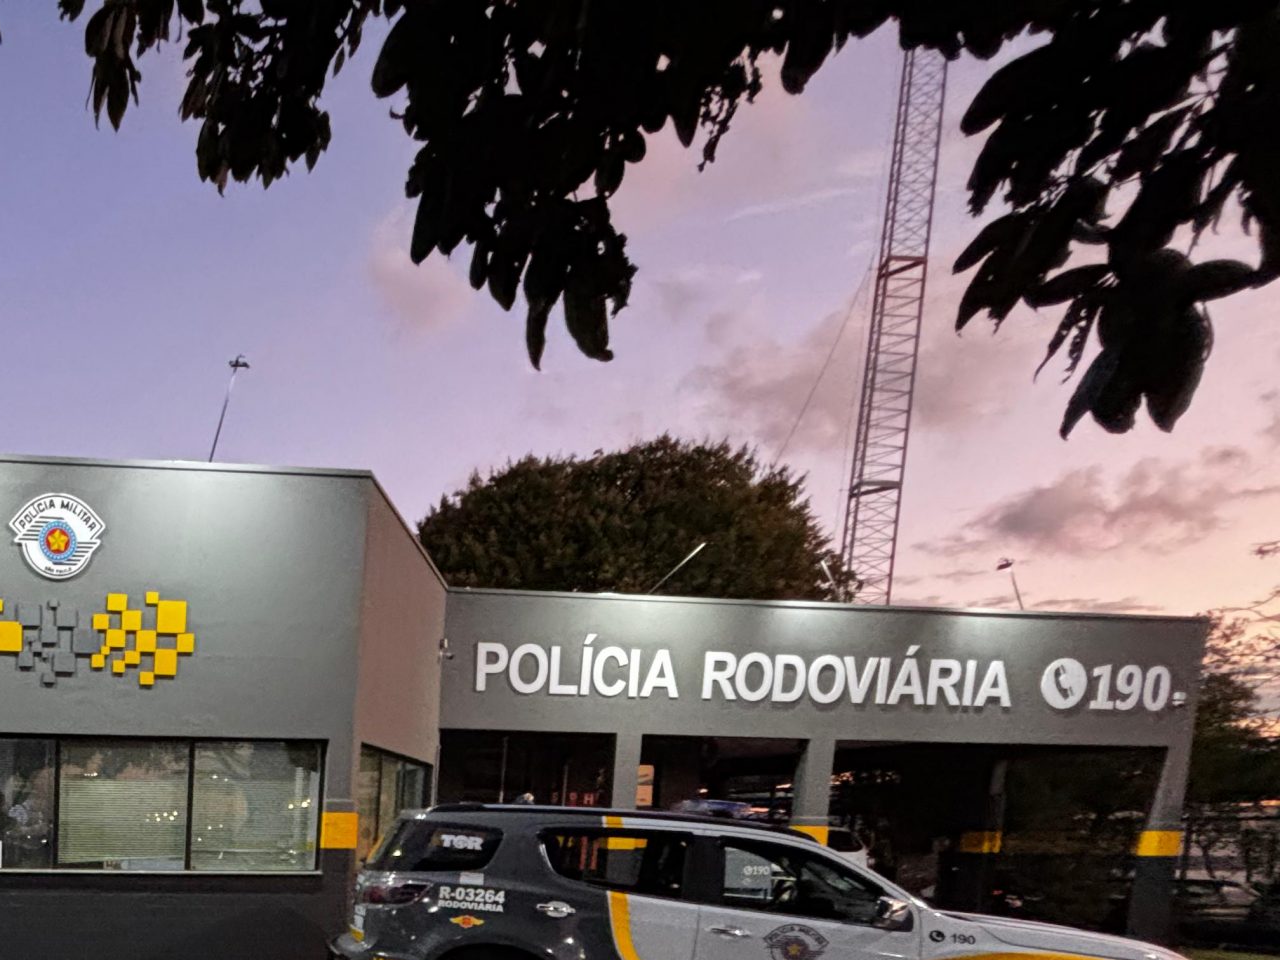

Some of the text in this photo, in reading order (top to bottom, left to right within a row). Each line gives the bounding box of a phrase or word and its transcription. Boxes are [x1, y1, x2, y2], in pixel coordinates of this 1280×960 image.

[18, 499, 97, 532] POLÍCIA MILITAR
[475, 632, 1171, 712] POLÍCIA RODOVIÁRIA 190
[440, 834, 484, 851] TOR
[439, 886, 505, 904] R-03264
[950, 933, 977, 945] 190
